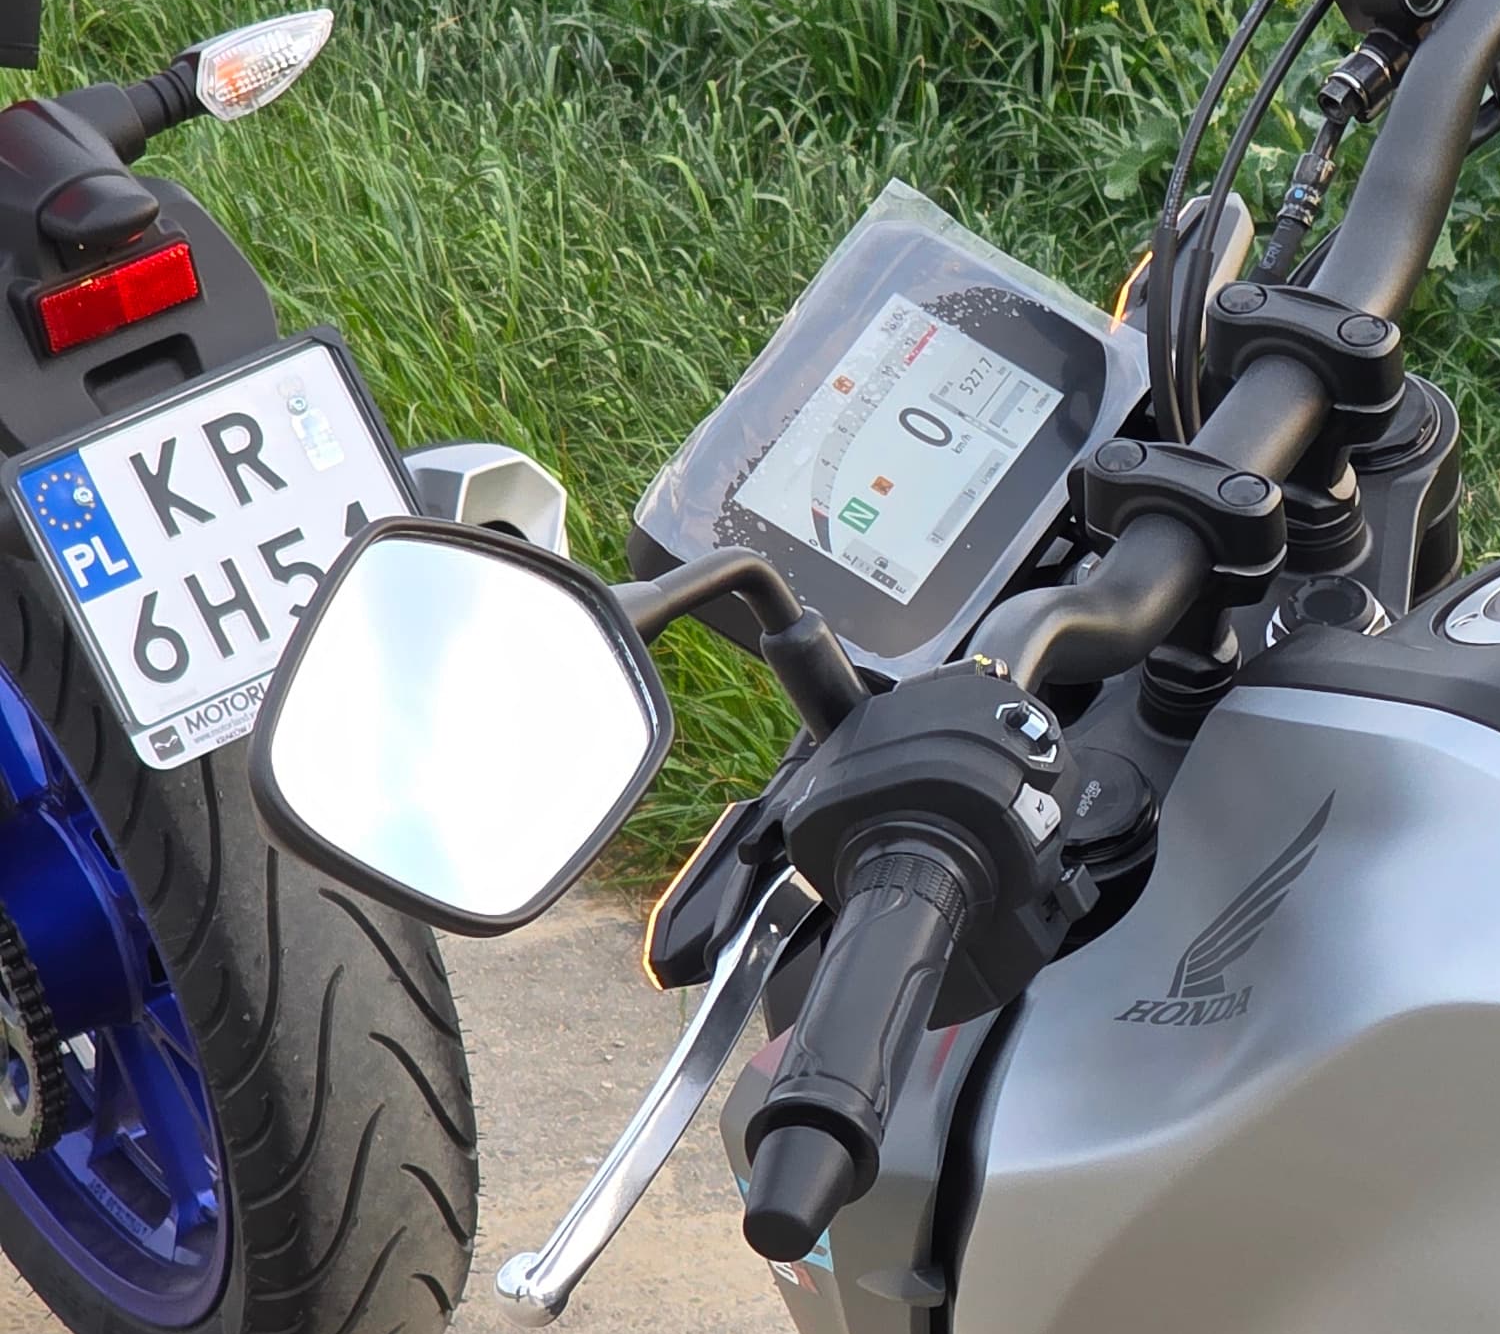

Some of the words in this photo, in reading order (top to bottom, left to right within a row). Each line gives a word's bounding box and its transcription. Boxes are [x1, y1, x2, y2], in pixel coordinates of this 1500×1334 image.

[959, 357, 992, 395] 527.7
[899, 407, 953, 448] 0
[952, 434, 972, 454] km/h
[129, 412, 288, 539] KR
[843, 500, 874, 529] N
[63, 537, 129, 589] PL
[1113, 985, 1254, 1026] HONDA
